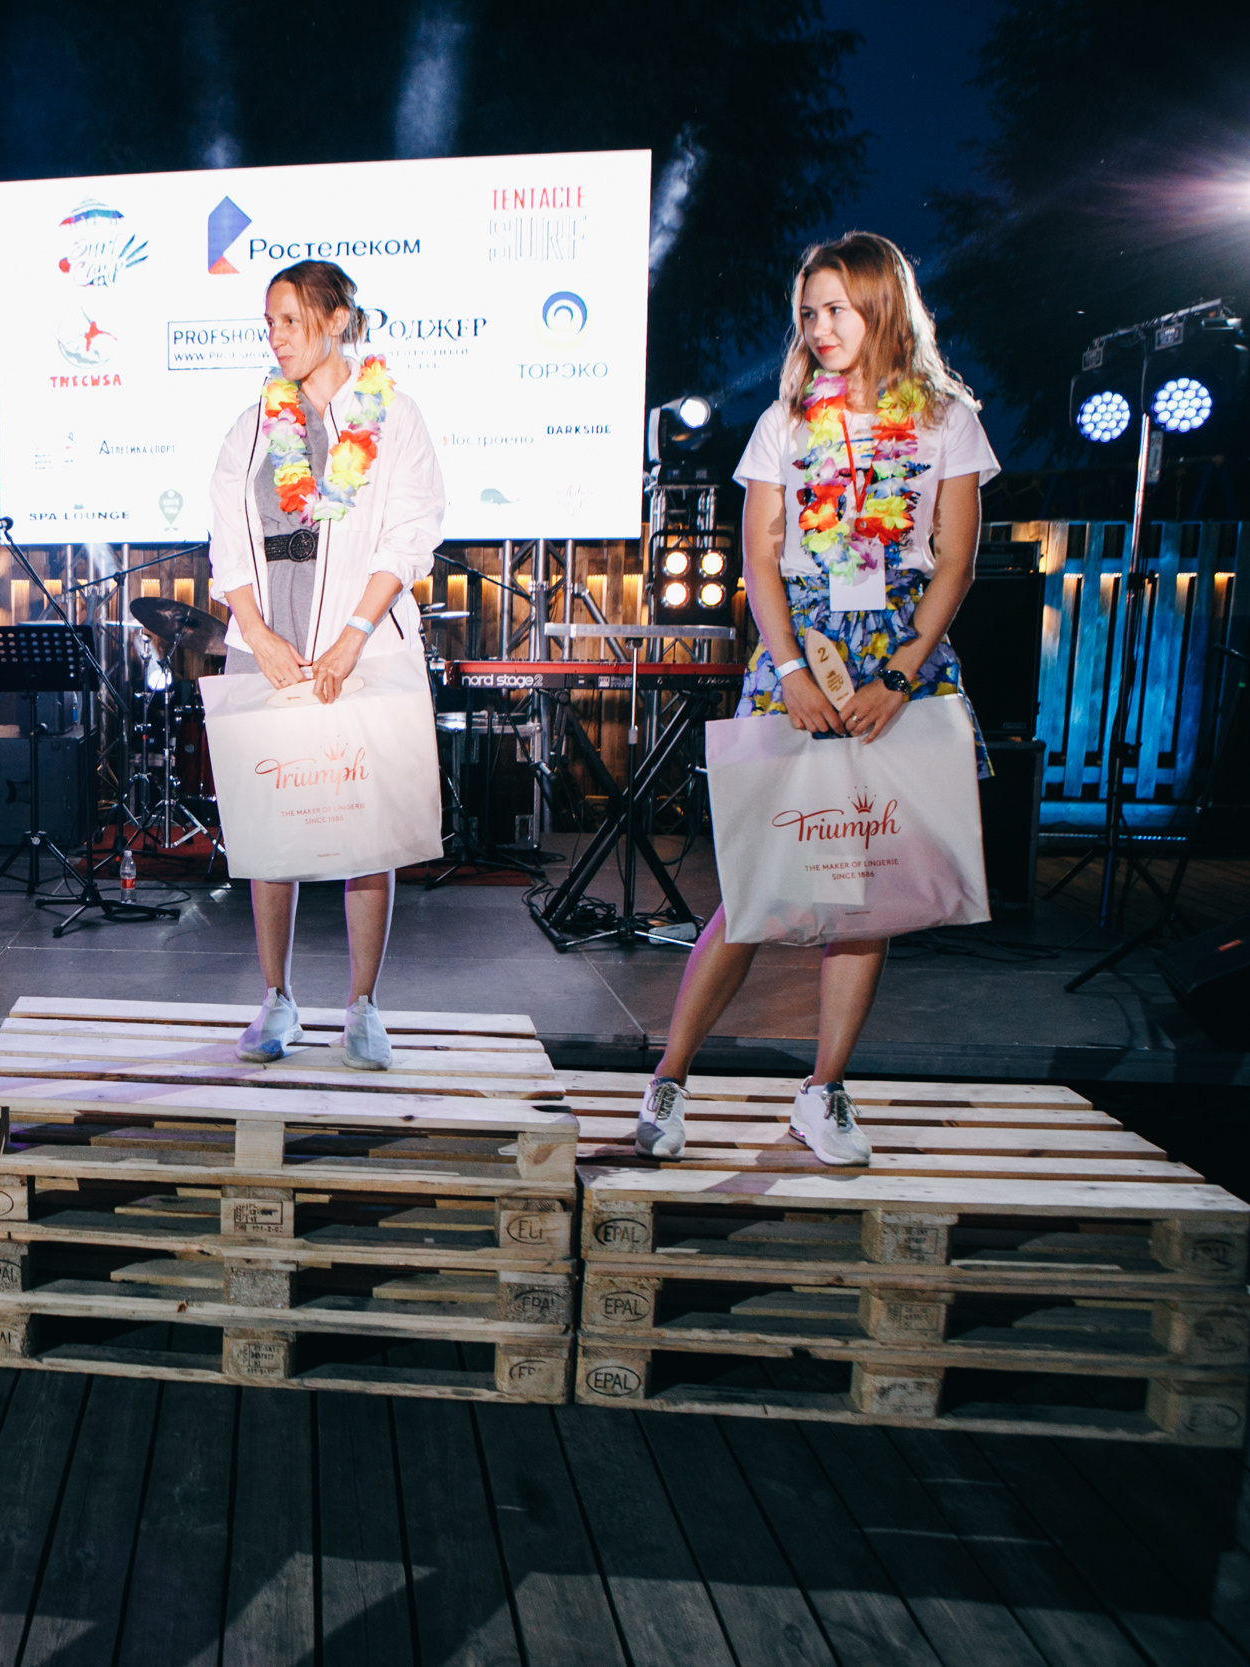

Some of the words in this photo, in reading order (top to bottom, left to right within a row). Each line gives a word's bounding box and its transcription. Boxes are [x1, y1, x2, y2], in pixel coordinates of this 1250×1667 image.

[492, 185, 587, 211] TENTACLE
[249, 238, 421, 261] Ростелеком
[518, 361, 609, 380] ТОРЭКО
[546, 424, 611, 436] DARKSIDE
[29, 512, 58, 521] SPA
[64, 511, 130, 521] LOUNGE
[817, 646, 830, 663] 2
[461, 674, 494, 687] nord
[254, 747, 370, 796] Triumph
[281, 810, 295, 818] THE
[296, 807, 321, 817] MAKER
[333, 803, 366, 812] LINGERIE
[304, 816, 326, 825] SINCE
[771, 799, 901, 850] Triumph
[804, 864, 821, 872] THE
[822, 861, 849, 870] MAKER
[863, 858, 899, 867] LINGERIE
[831, 871, 856, 881] SINCE
[857, 870, 875, 879] 1886
[603, 1224, 641, 1243] EPAL
[604, 1299, 643, 1316] EPAL
[594, 1372, 633, 1391] EPAL
